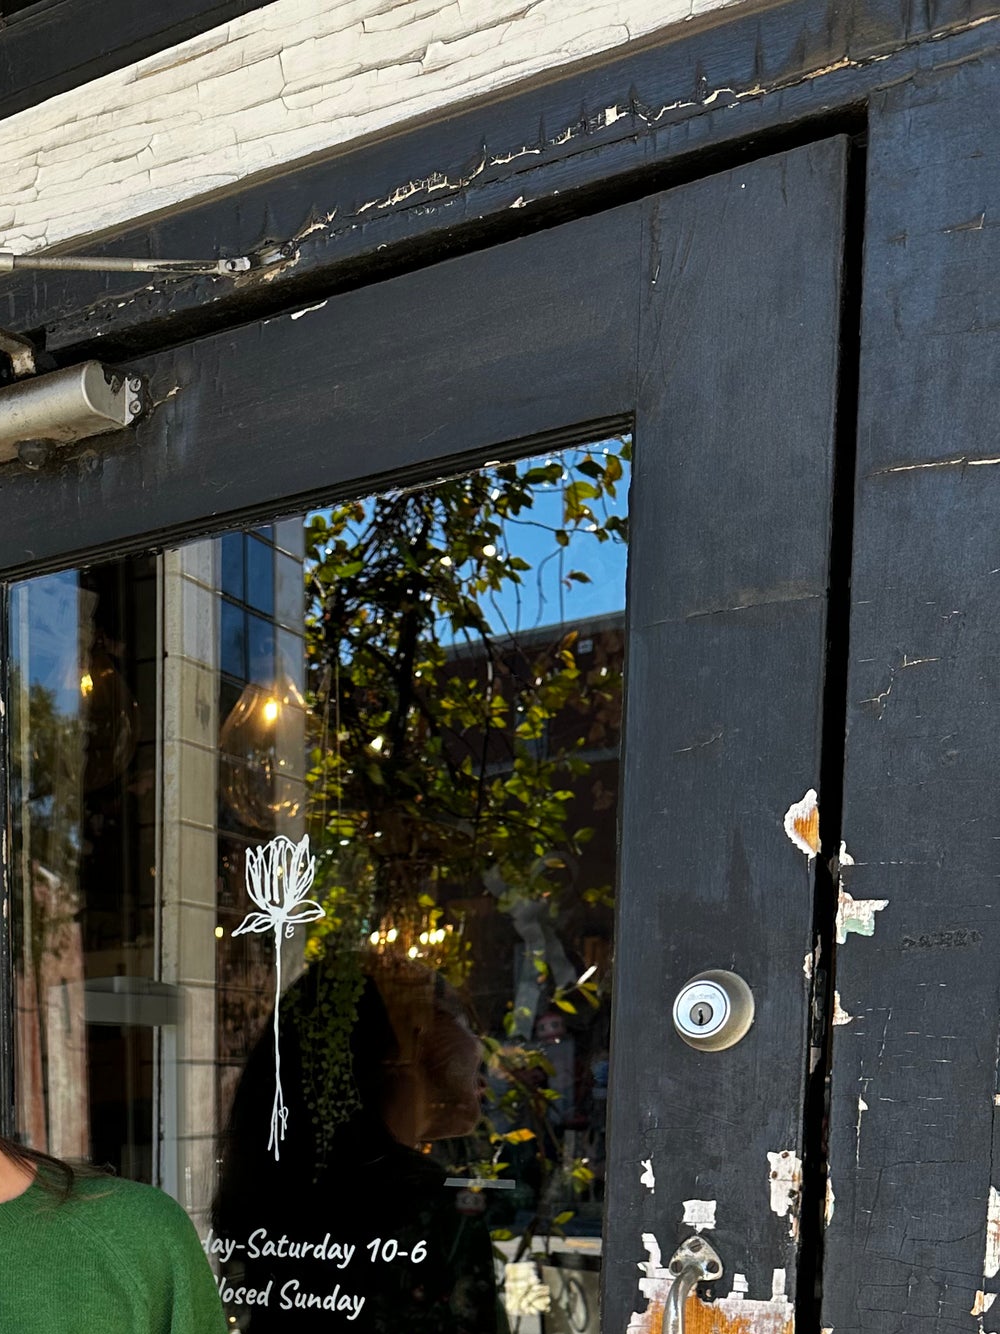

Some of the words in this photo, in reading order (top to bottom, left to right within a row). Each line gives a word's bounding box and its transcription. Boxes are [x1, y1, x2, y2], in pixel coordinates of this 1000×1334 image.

[366, 1238, 427, 1263] 10-6
[213, 1274, 273, 1307] losed
[279, 1279, 366, 1320] Sunday
